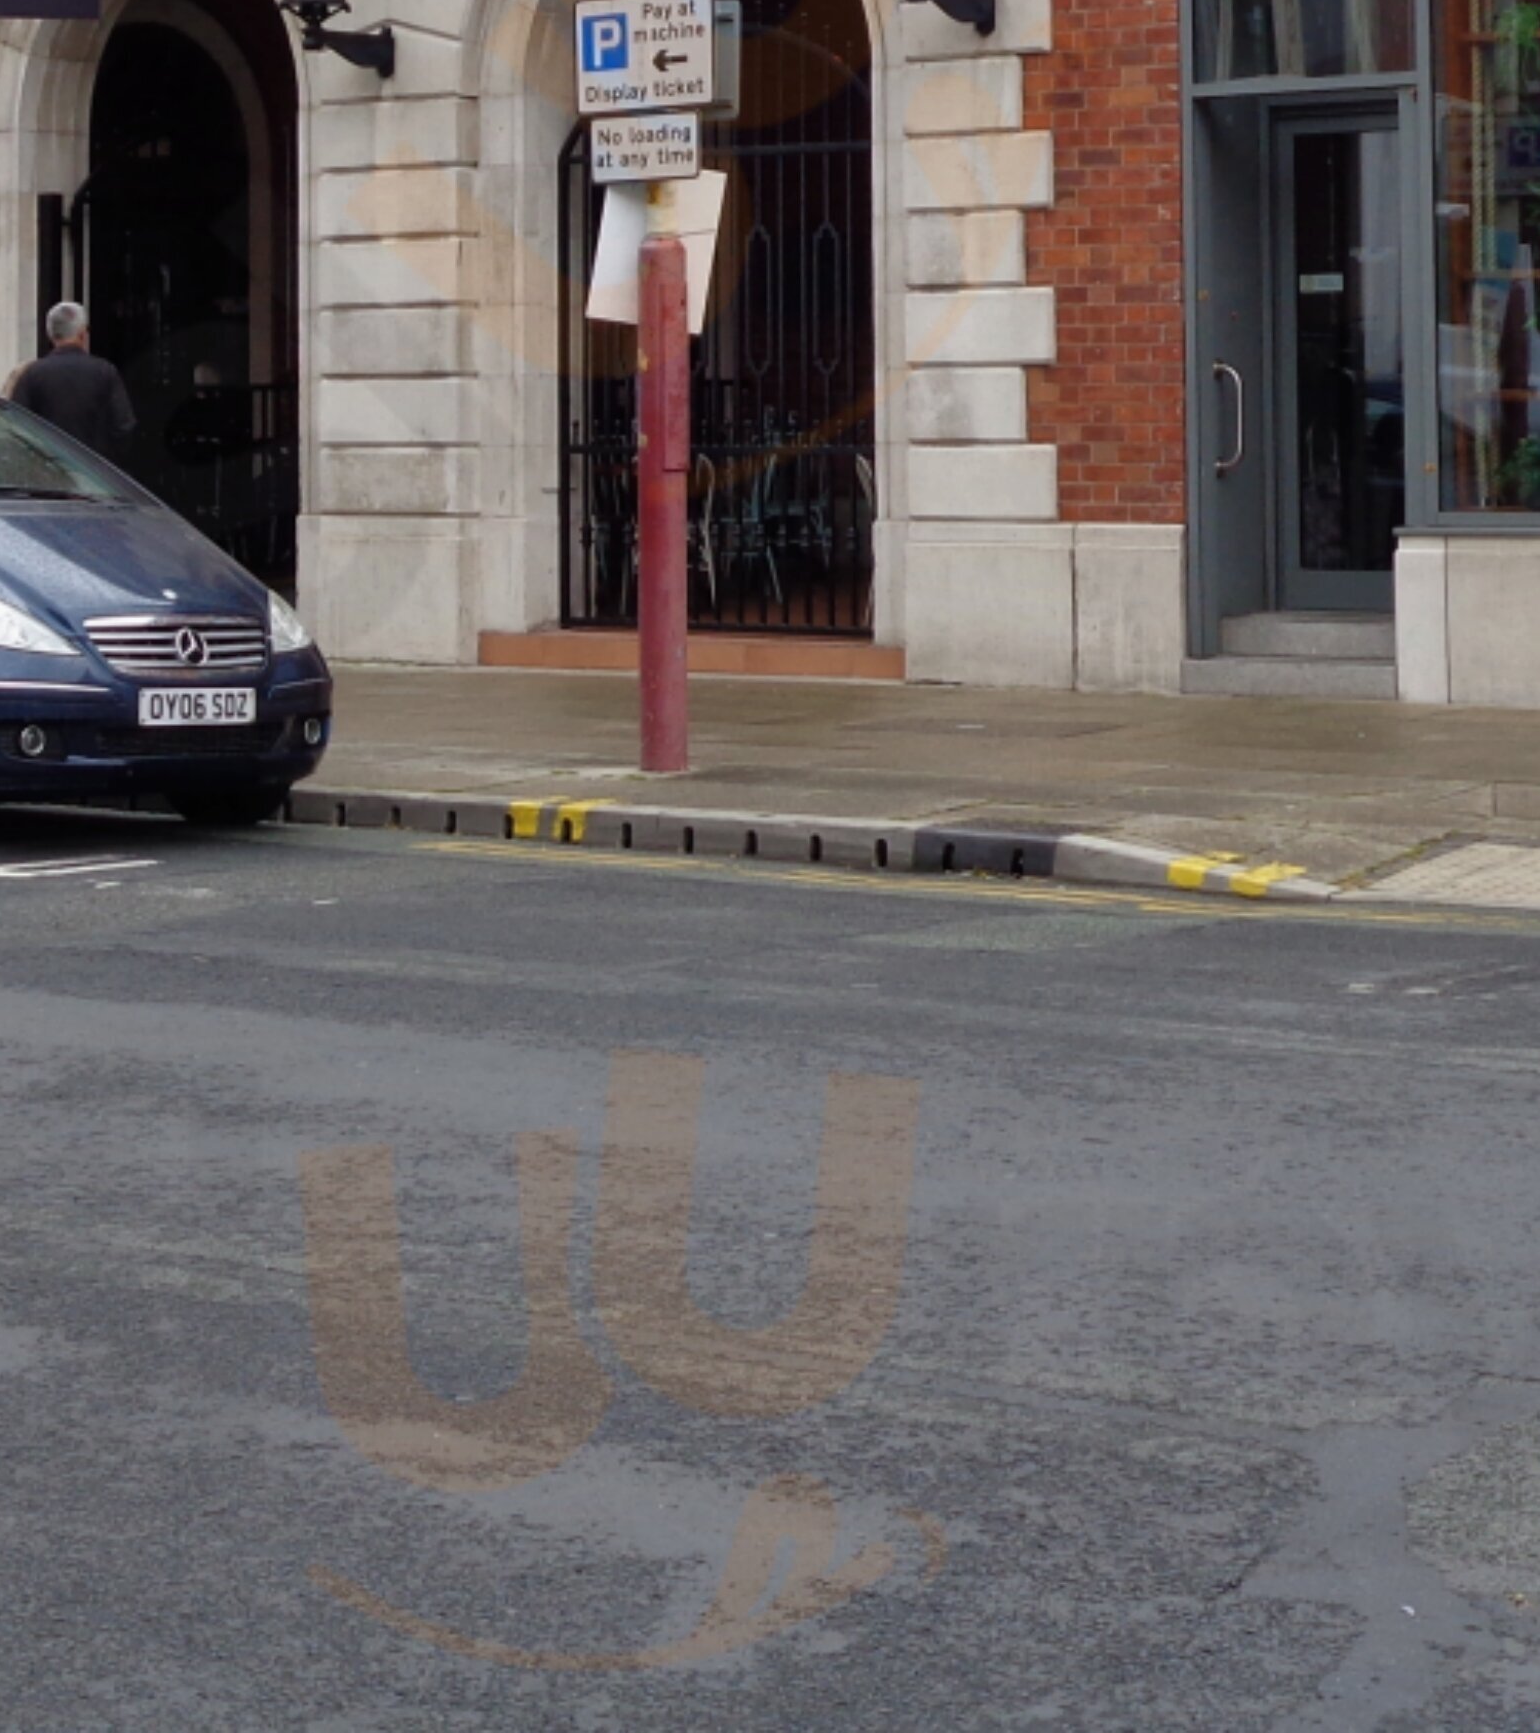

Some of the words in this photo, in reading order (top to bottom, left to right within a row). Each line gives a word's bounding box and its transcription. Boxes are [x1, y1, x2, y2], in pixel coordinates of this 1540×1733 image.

[642, 3, 672, 19] Pay
[633, 22, 706, 43] machine
[592, 20, 621, 67] P
[585, 84, 647, 105] Display
[653, 78, 703, 97] ticket
[598, 128, 623, 145] No
[628, 124, 691, 143] loading
[597, 152, 612, 168] at
[619, 153, 649, 167] any
[657, 148, 694, 165] time
